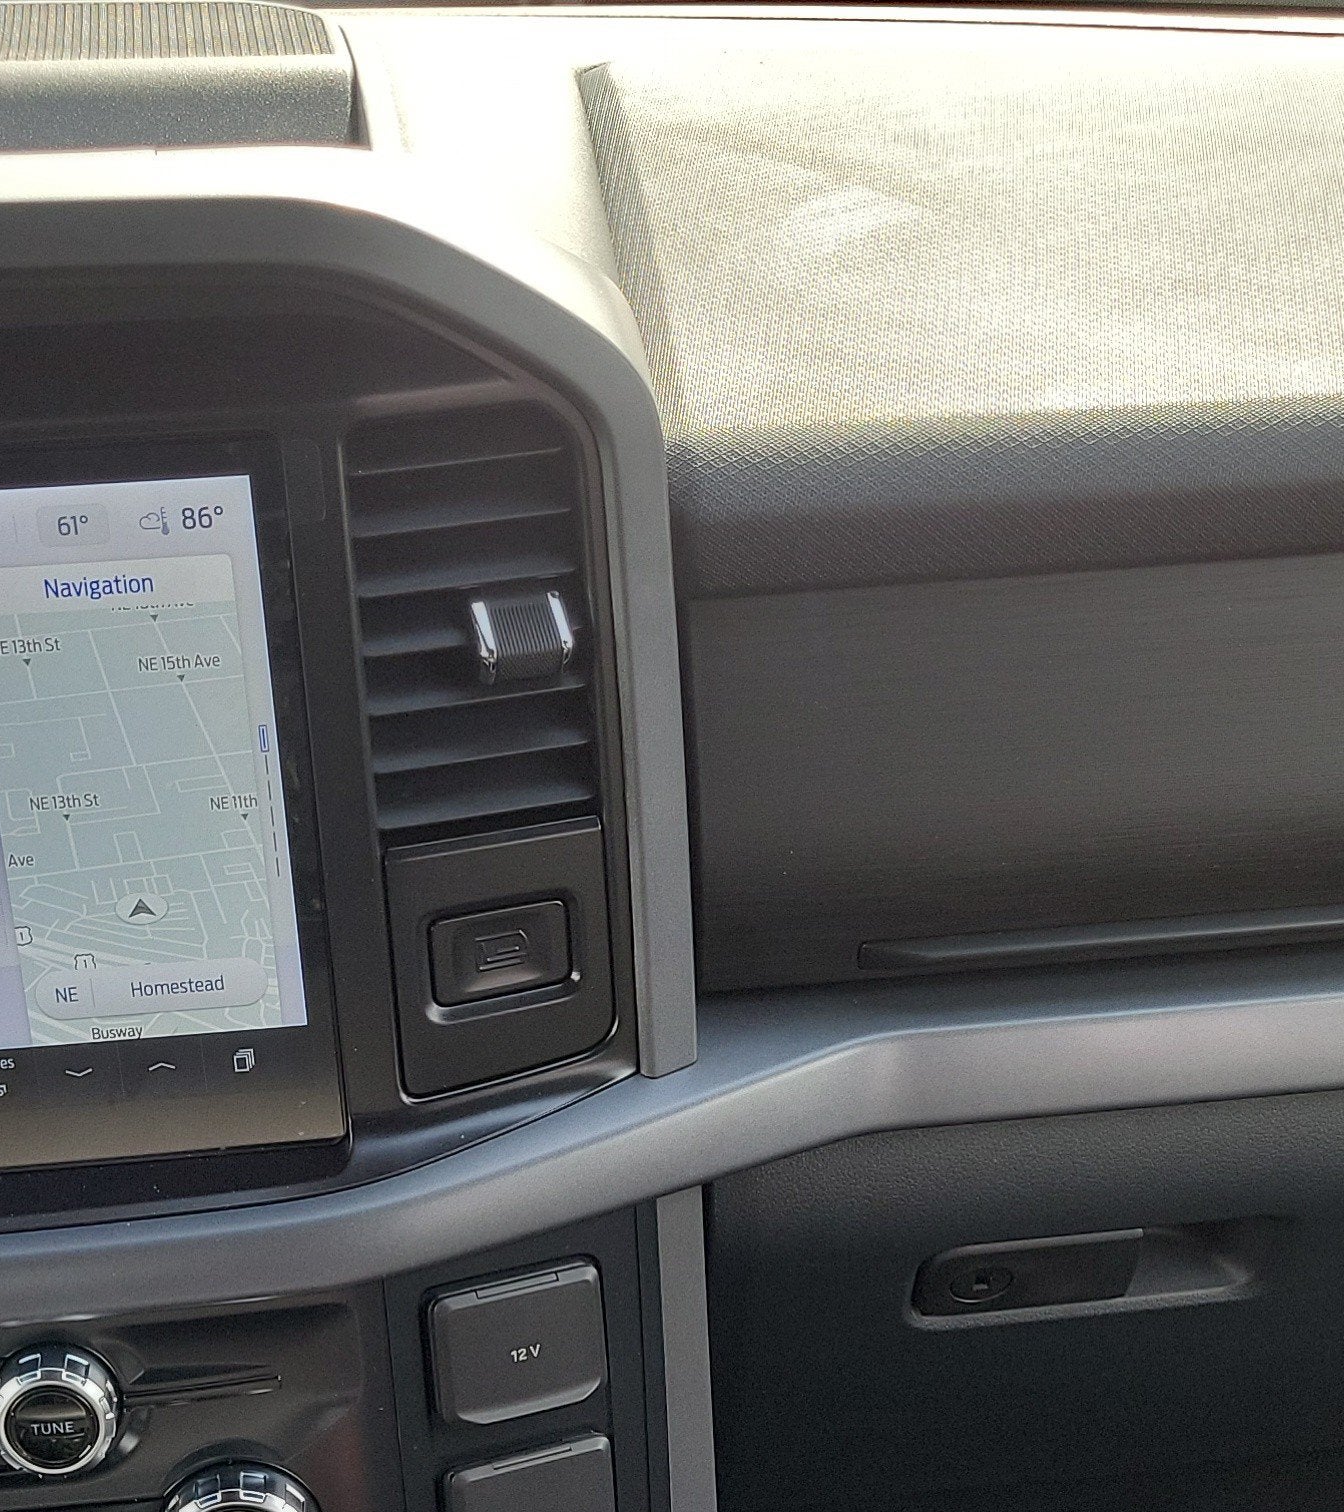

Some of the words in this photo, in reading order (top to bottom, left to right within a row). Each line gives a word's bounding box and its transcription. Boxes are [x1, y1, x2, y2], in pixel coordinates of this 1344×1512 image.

[56, 514, 89, 537] 61°
[181, 505, 224, 531] 86°
[43, 571, 154, 600] Navigation
[12, 639, 42, 653] 13th
[45, 637, 61, 652] St
[138, 657, 158, 672] NE
[161, 655, 190, 670] 15th
[194, 654, 220, 668] Ave
[29, 797, 49, 811] NE
[52, 795, 81, 809] 13th
[84, 793, 100, 807] St
[210, 797, 229, 811] NE
[233, 794, 258, 808] 11th
[8, 854, 35, 867] Ave
[55, 986, 79, 1003] NE
[130, 975, 225, 998] Homestead
[91, 1023, 143, 1041] Busway
[510, 1347, 527, 1363] 12
[529, 1344, 541, 1358] V
[31, 1420, 75, 1435] TUNE
